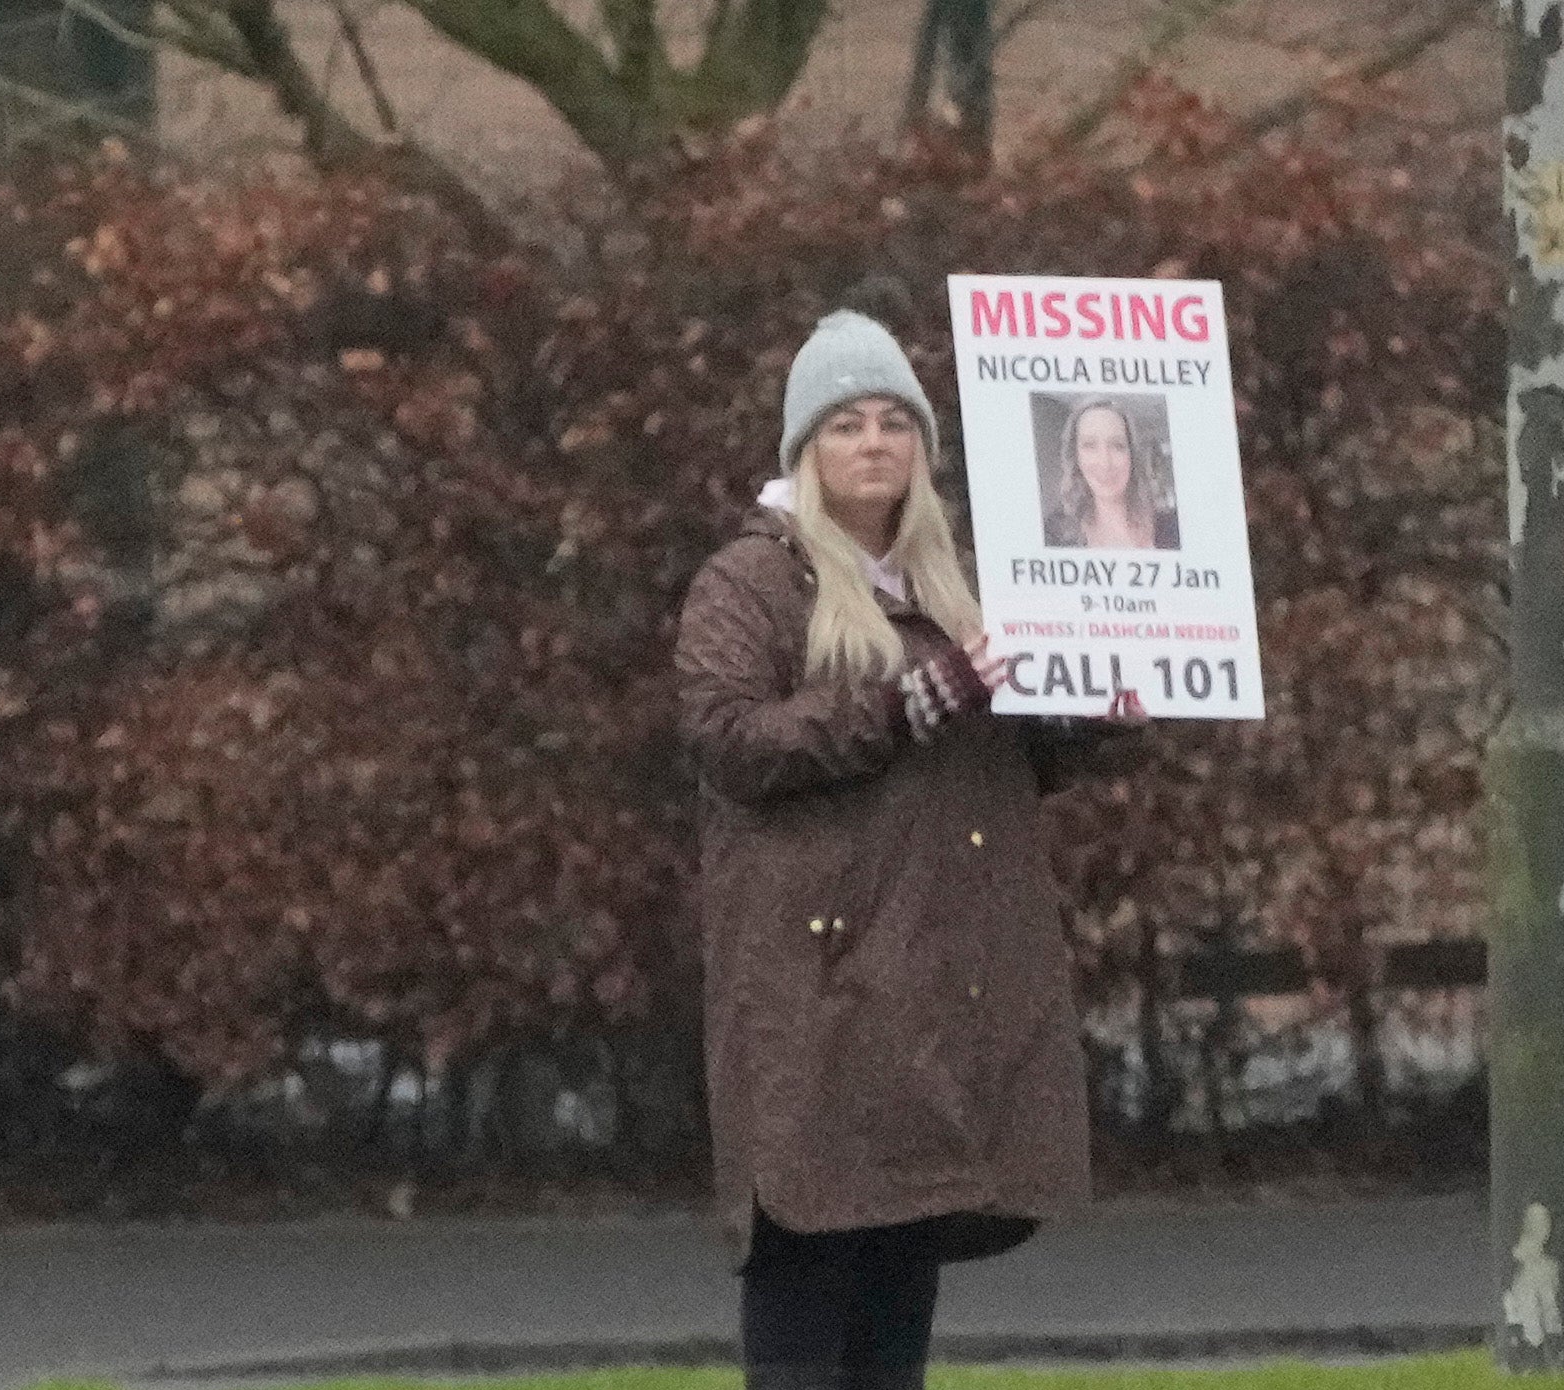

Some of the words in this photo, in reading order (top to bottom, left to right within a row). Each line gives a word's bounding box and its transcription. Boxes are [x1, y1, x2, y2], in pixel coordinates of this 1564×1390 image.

[970, 290, 1211, 342] MISSING
[978, 355, 1091, 382] NICOLA
[1101, 357, 1211, 387] BULLEY
[1011, 559, 1119, 587] FRIDAY
[1127, 562, 1161, 589] 27
[1171, 561, 1220, 590] Jan
[1081, 595, 1157, 613] 9-10am
[1002, 621, 1075, 638] WITNESS
[1088, 622, 1171, 640] DASHCAM
[1175, 625, 1241, 642] NEEDED
[1007, 652, 1128, 698] CALL
[1154, 657, 1240, 700] 101
